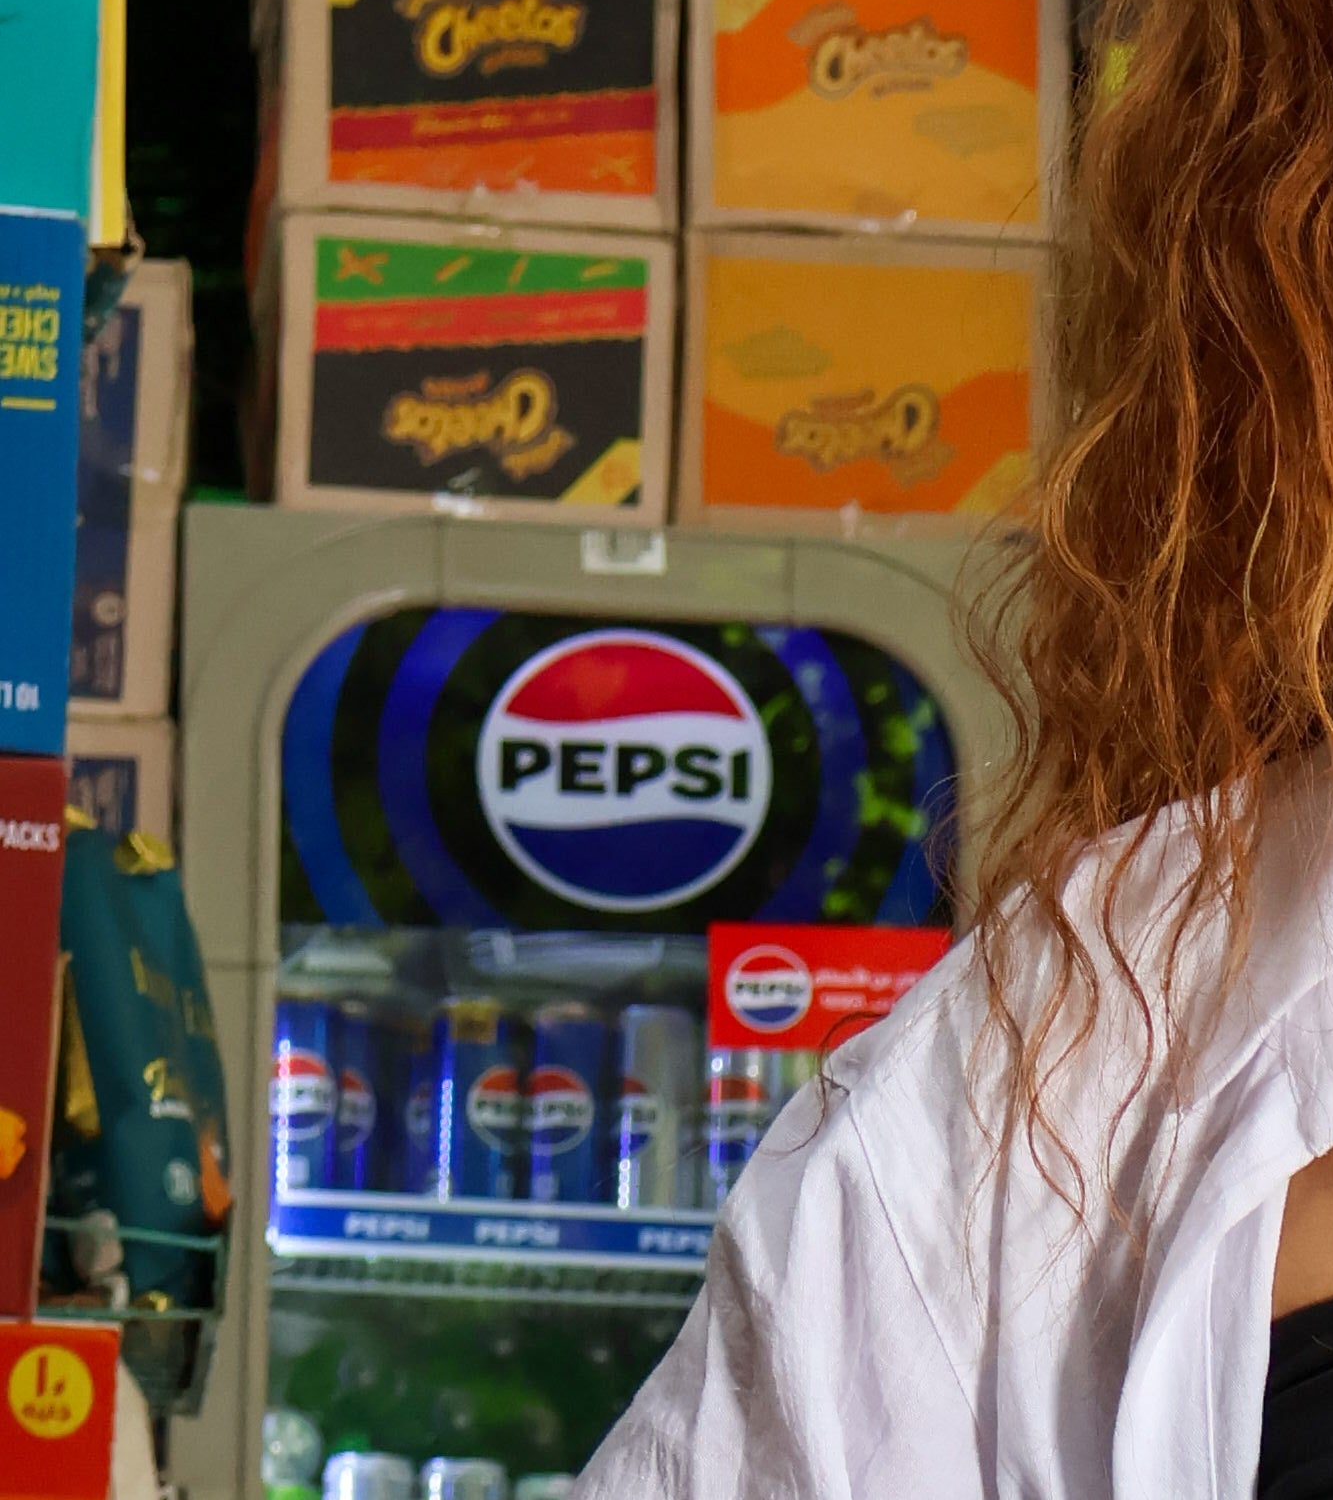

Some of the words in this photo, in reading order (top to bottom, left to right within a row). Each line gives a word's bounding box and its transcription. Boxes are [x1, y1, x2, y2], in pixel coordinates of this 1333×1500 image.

[500, 741, 753, 803] PEPSI
[344, 1215, 431, 1242] PEPSI
[475, 1219, 561, 1247] PEPSI
